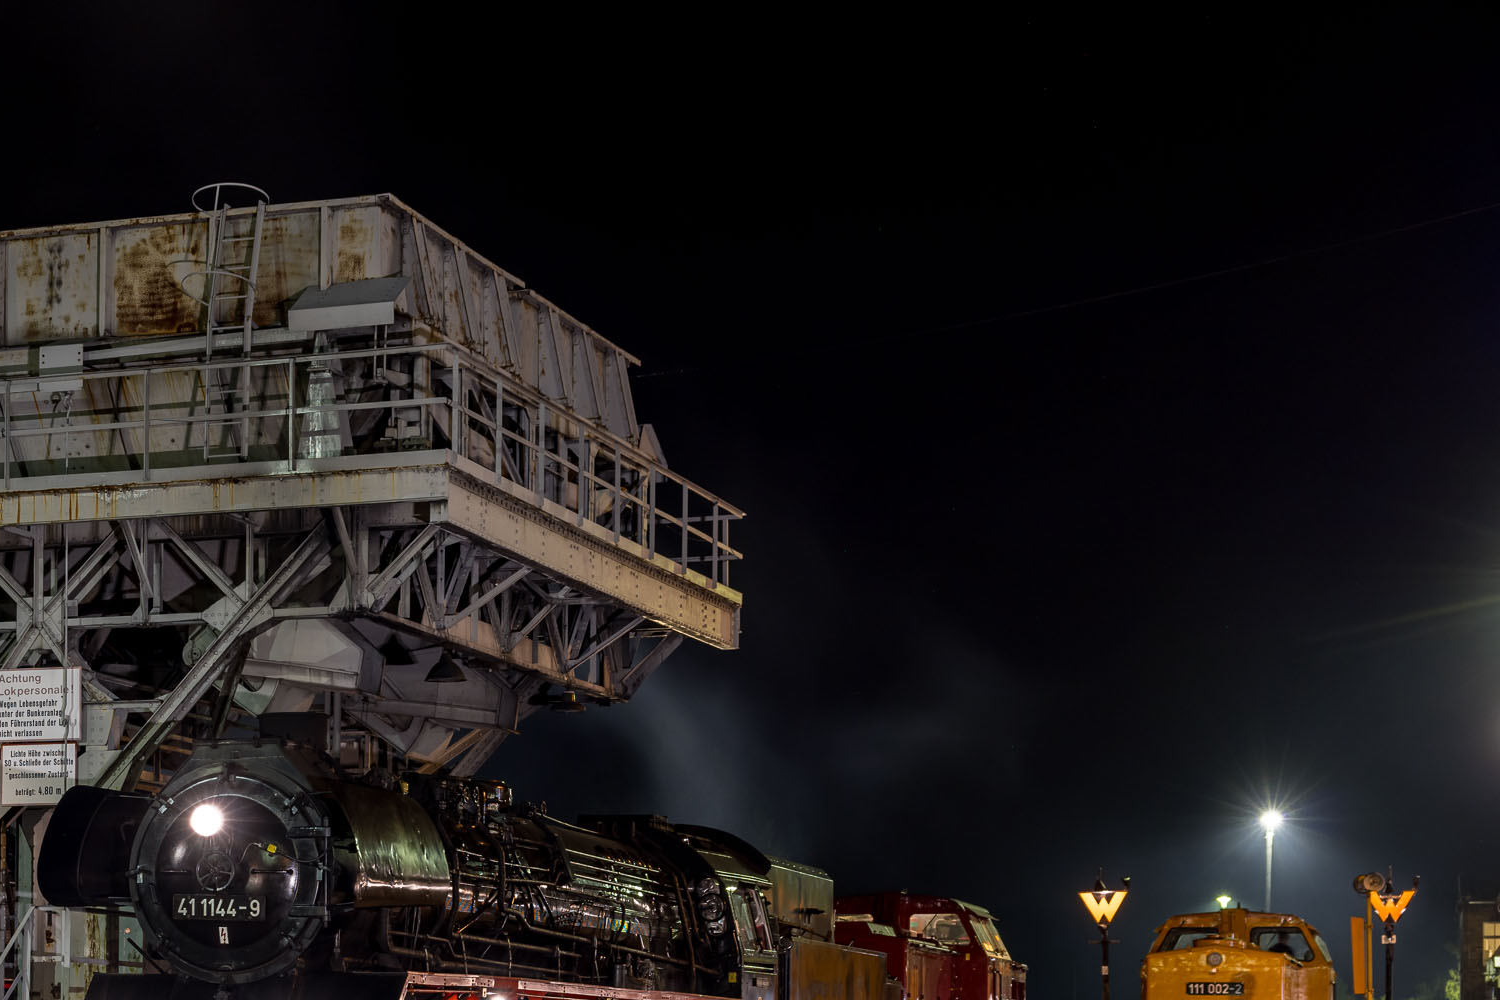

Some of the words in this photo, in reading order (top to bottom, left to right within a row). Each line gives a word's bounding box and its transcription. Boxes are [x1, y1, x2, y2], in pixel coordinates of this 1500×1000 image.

[19, 699, 58, 708] Lebensgefahr
[15, 709, 25, 718] der
[27, 708, 65, 718] Bunkeranlag
[11, 718, 45, 728] Führerstand
[47, 718, 56, 727] der
[15, 729, 43, 738] verlassen
[10, 750, 26, 758] Lichte
[28, 749, 41, 757] Höhe
[19, 759, 41, 767] Schließe
[43, 758, 52, 766] der
[56, 787, 62, 795] m
[178, 897, 196, 917] 41
[201, 897, 261, 918] 1144-9
[1078, 891, 1128, 923] W
[1370, 890, 1415, 923] W
[1188, 983, 1205, 994] 111
[1208, 983, 1242, 995] 002-2
